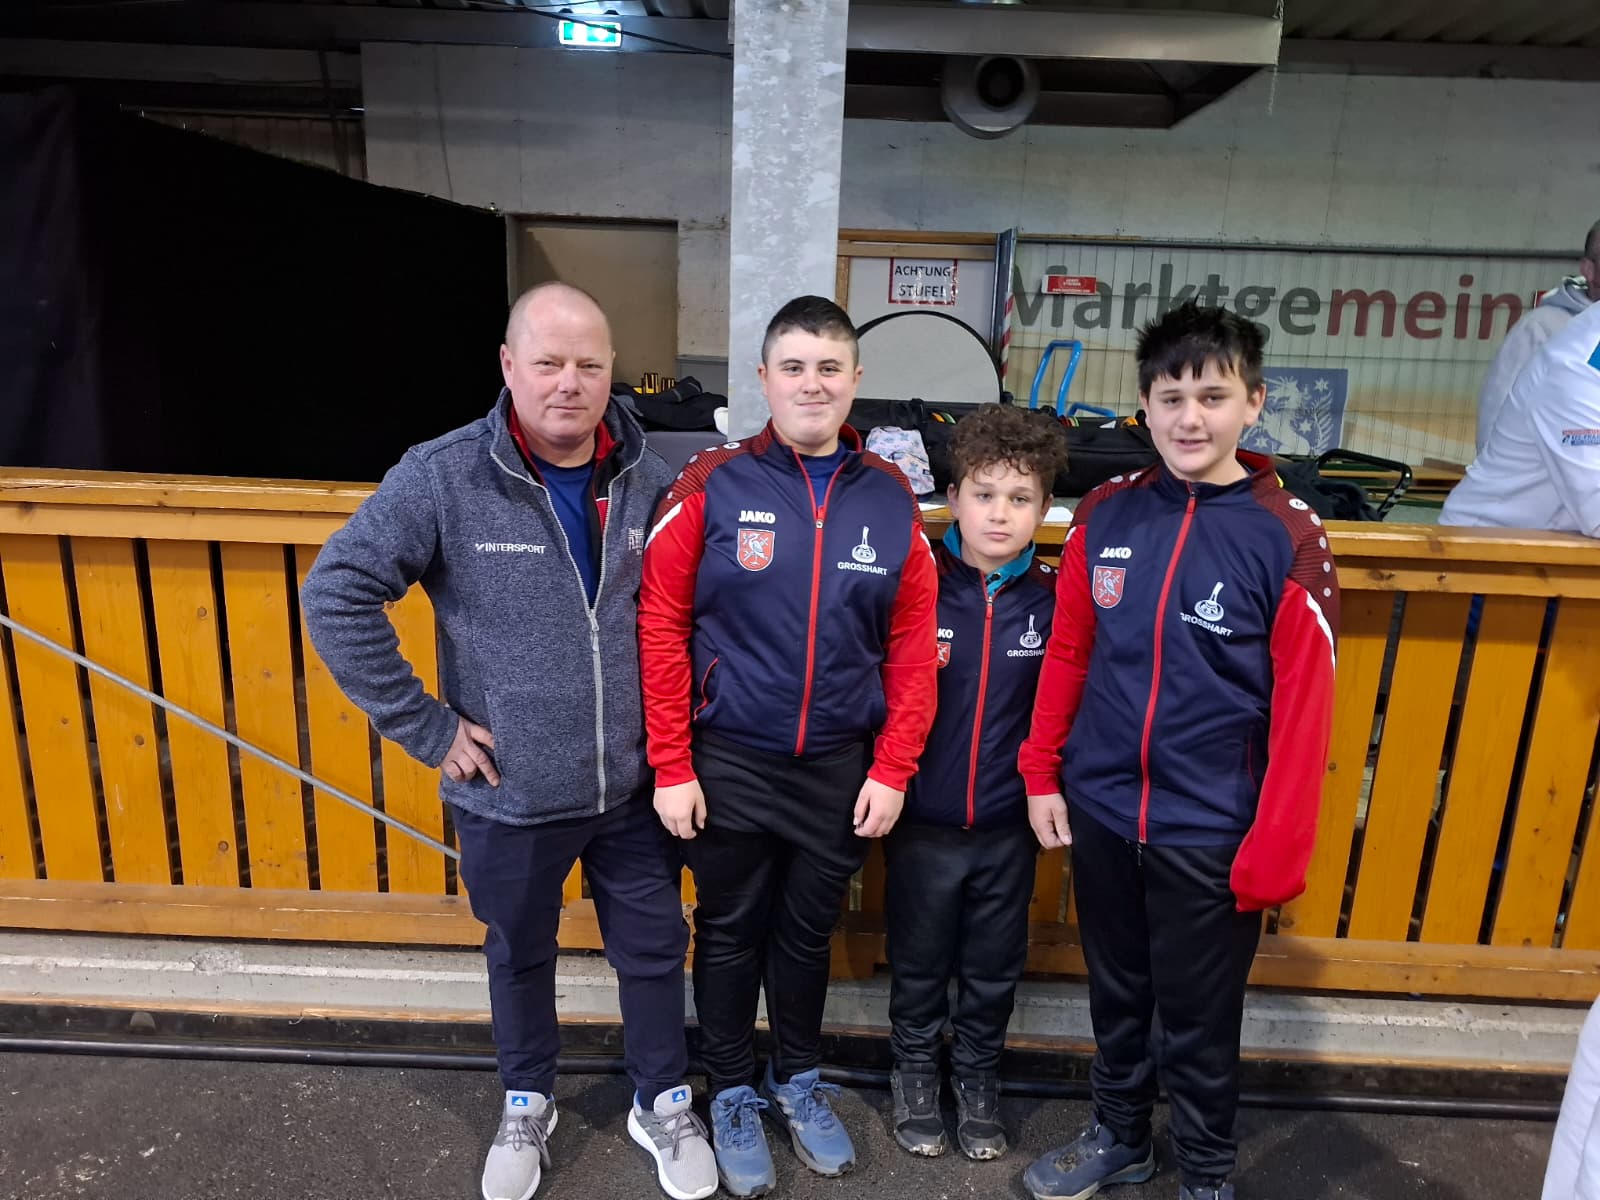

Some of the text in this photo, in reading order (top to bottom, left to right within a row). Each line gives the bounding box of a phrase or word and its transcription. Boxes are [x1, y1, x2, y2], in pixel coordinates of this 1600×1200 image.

[894, 265, 951, 277] ACHTUNG
[898, 284, 944, 298] STUFE!
[1011, 262, 1523, 345] Marktgemein
[738, 510, 776, 524] JAKO
[485, 542, 546, 554] INTERSPORT
[1099, 547, 1133, 559] JAKO
[837, 561, 888, 576] GROSSHART
[937, 628, 954, 639] KO
